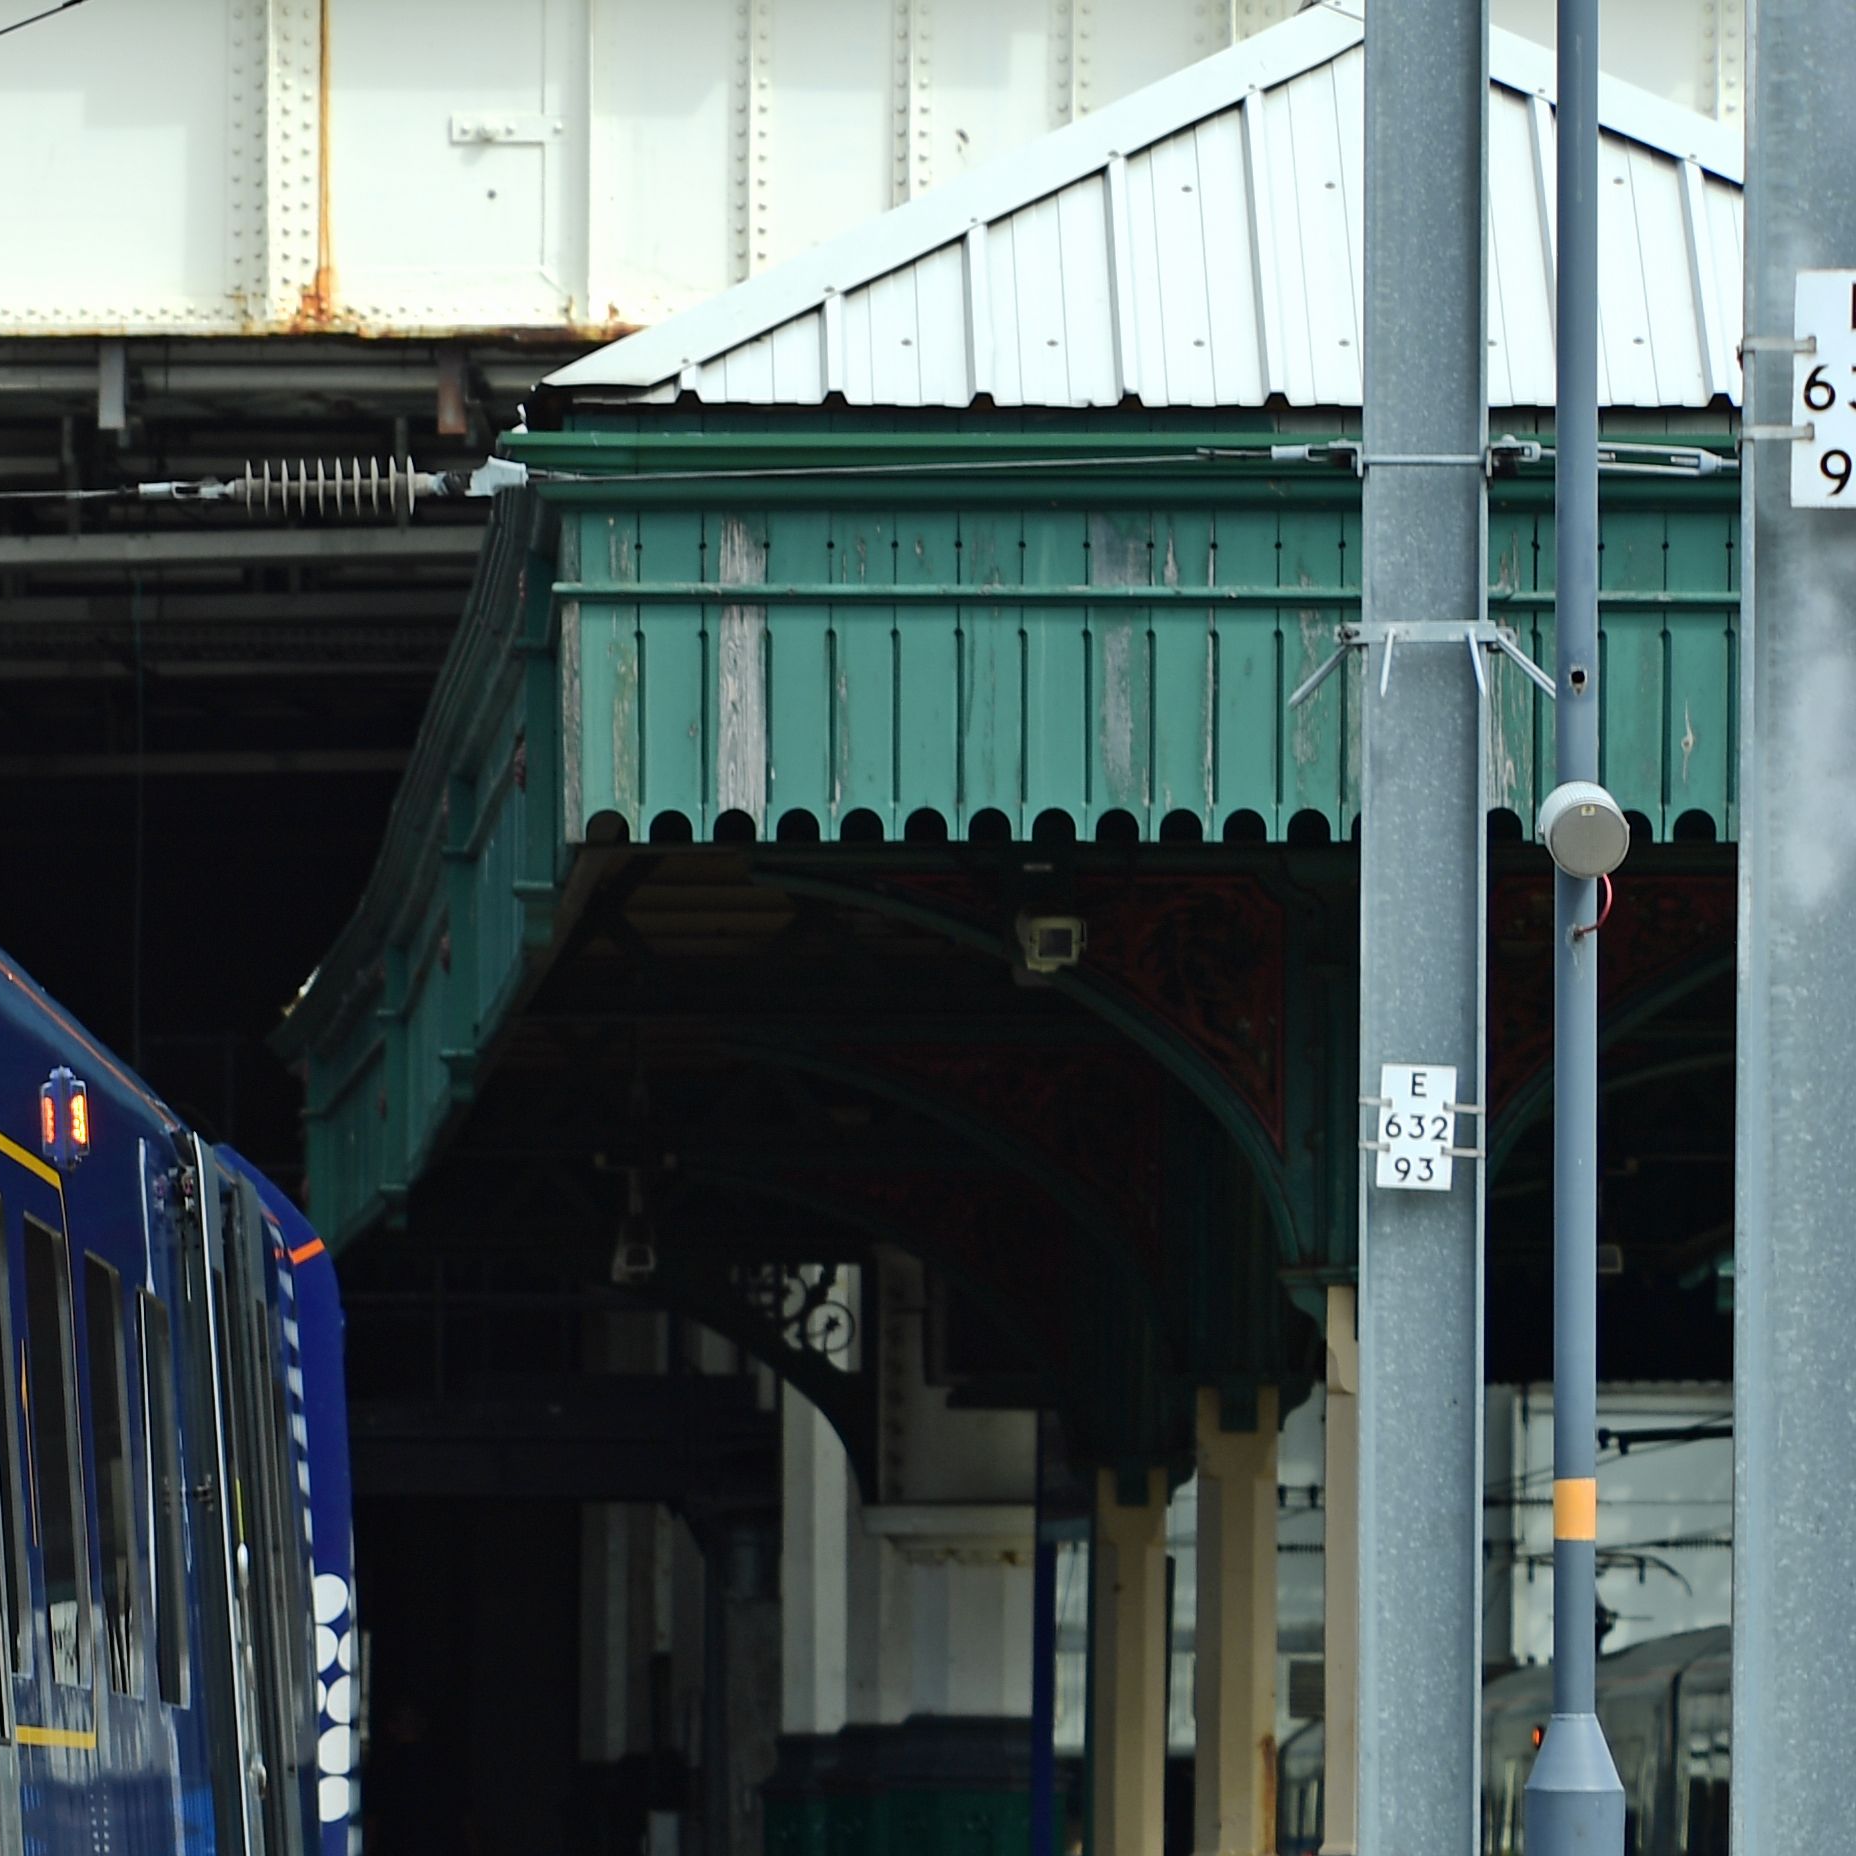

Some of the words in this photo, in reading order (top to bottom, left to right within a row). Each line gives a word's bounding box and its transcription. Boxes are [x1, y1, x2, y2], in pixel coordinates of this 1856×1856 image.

[1803, 364, 1856, 412] 6
[1411, 1072, 1427, 1097] E
[1385, 1114, 1448, 1141] 632
[1394, 1157, 1434, 1182] 93
